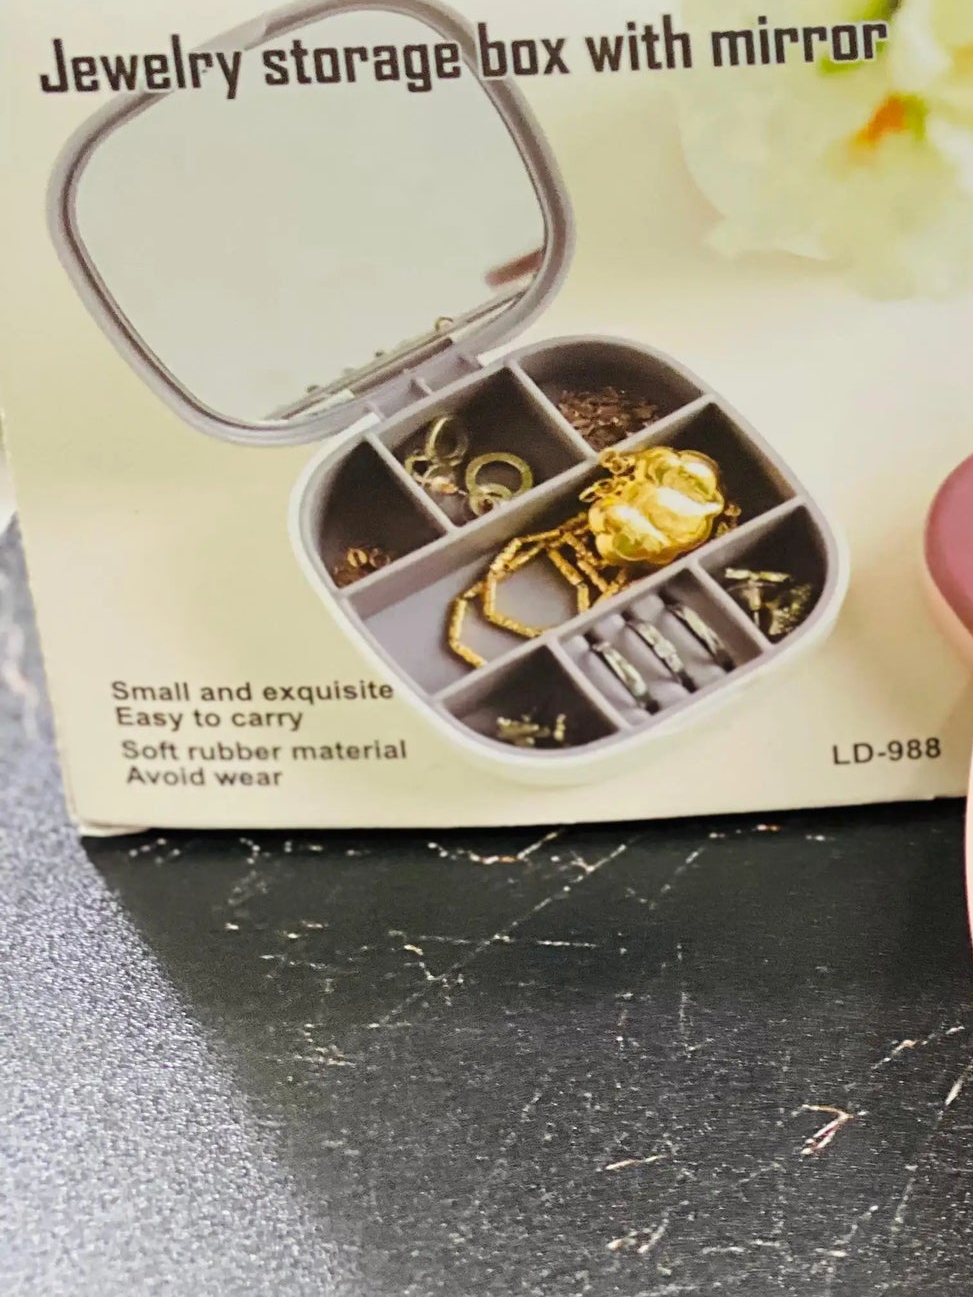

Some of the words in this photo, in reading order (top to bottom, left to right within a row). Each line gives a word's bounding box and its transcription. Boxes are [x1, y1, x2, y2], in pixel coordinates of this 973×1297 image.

[40, 34, 242, 99] Jewelry
[262, 39, 461, 93] storage
[477, 22, 570, 77] box
[585, 14, 693, 72] with
[711, 15, 888, 67] mirror
[111, 681, 190, 702] Small
[200, 681, 253, 702] and
[262, 680, 394, 704] exquisite
[115, 706, 184, 732] Easy
[194, 708, 221, 728] to
[231, 711, 304, 732] carry
[121, 739, 180, 761] Soft
[188, 741, 281, 761] rubber
[291, 739, 408, 760] material
[832, 736, 942, 766] LD-988
[126, 766, 205, 787] Avoid
[214, 769, 284, 787] wear
